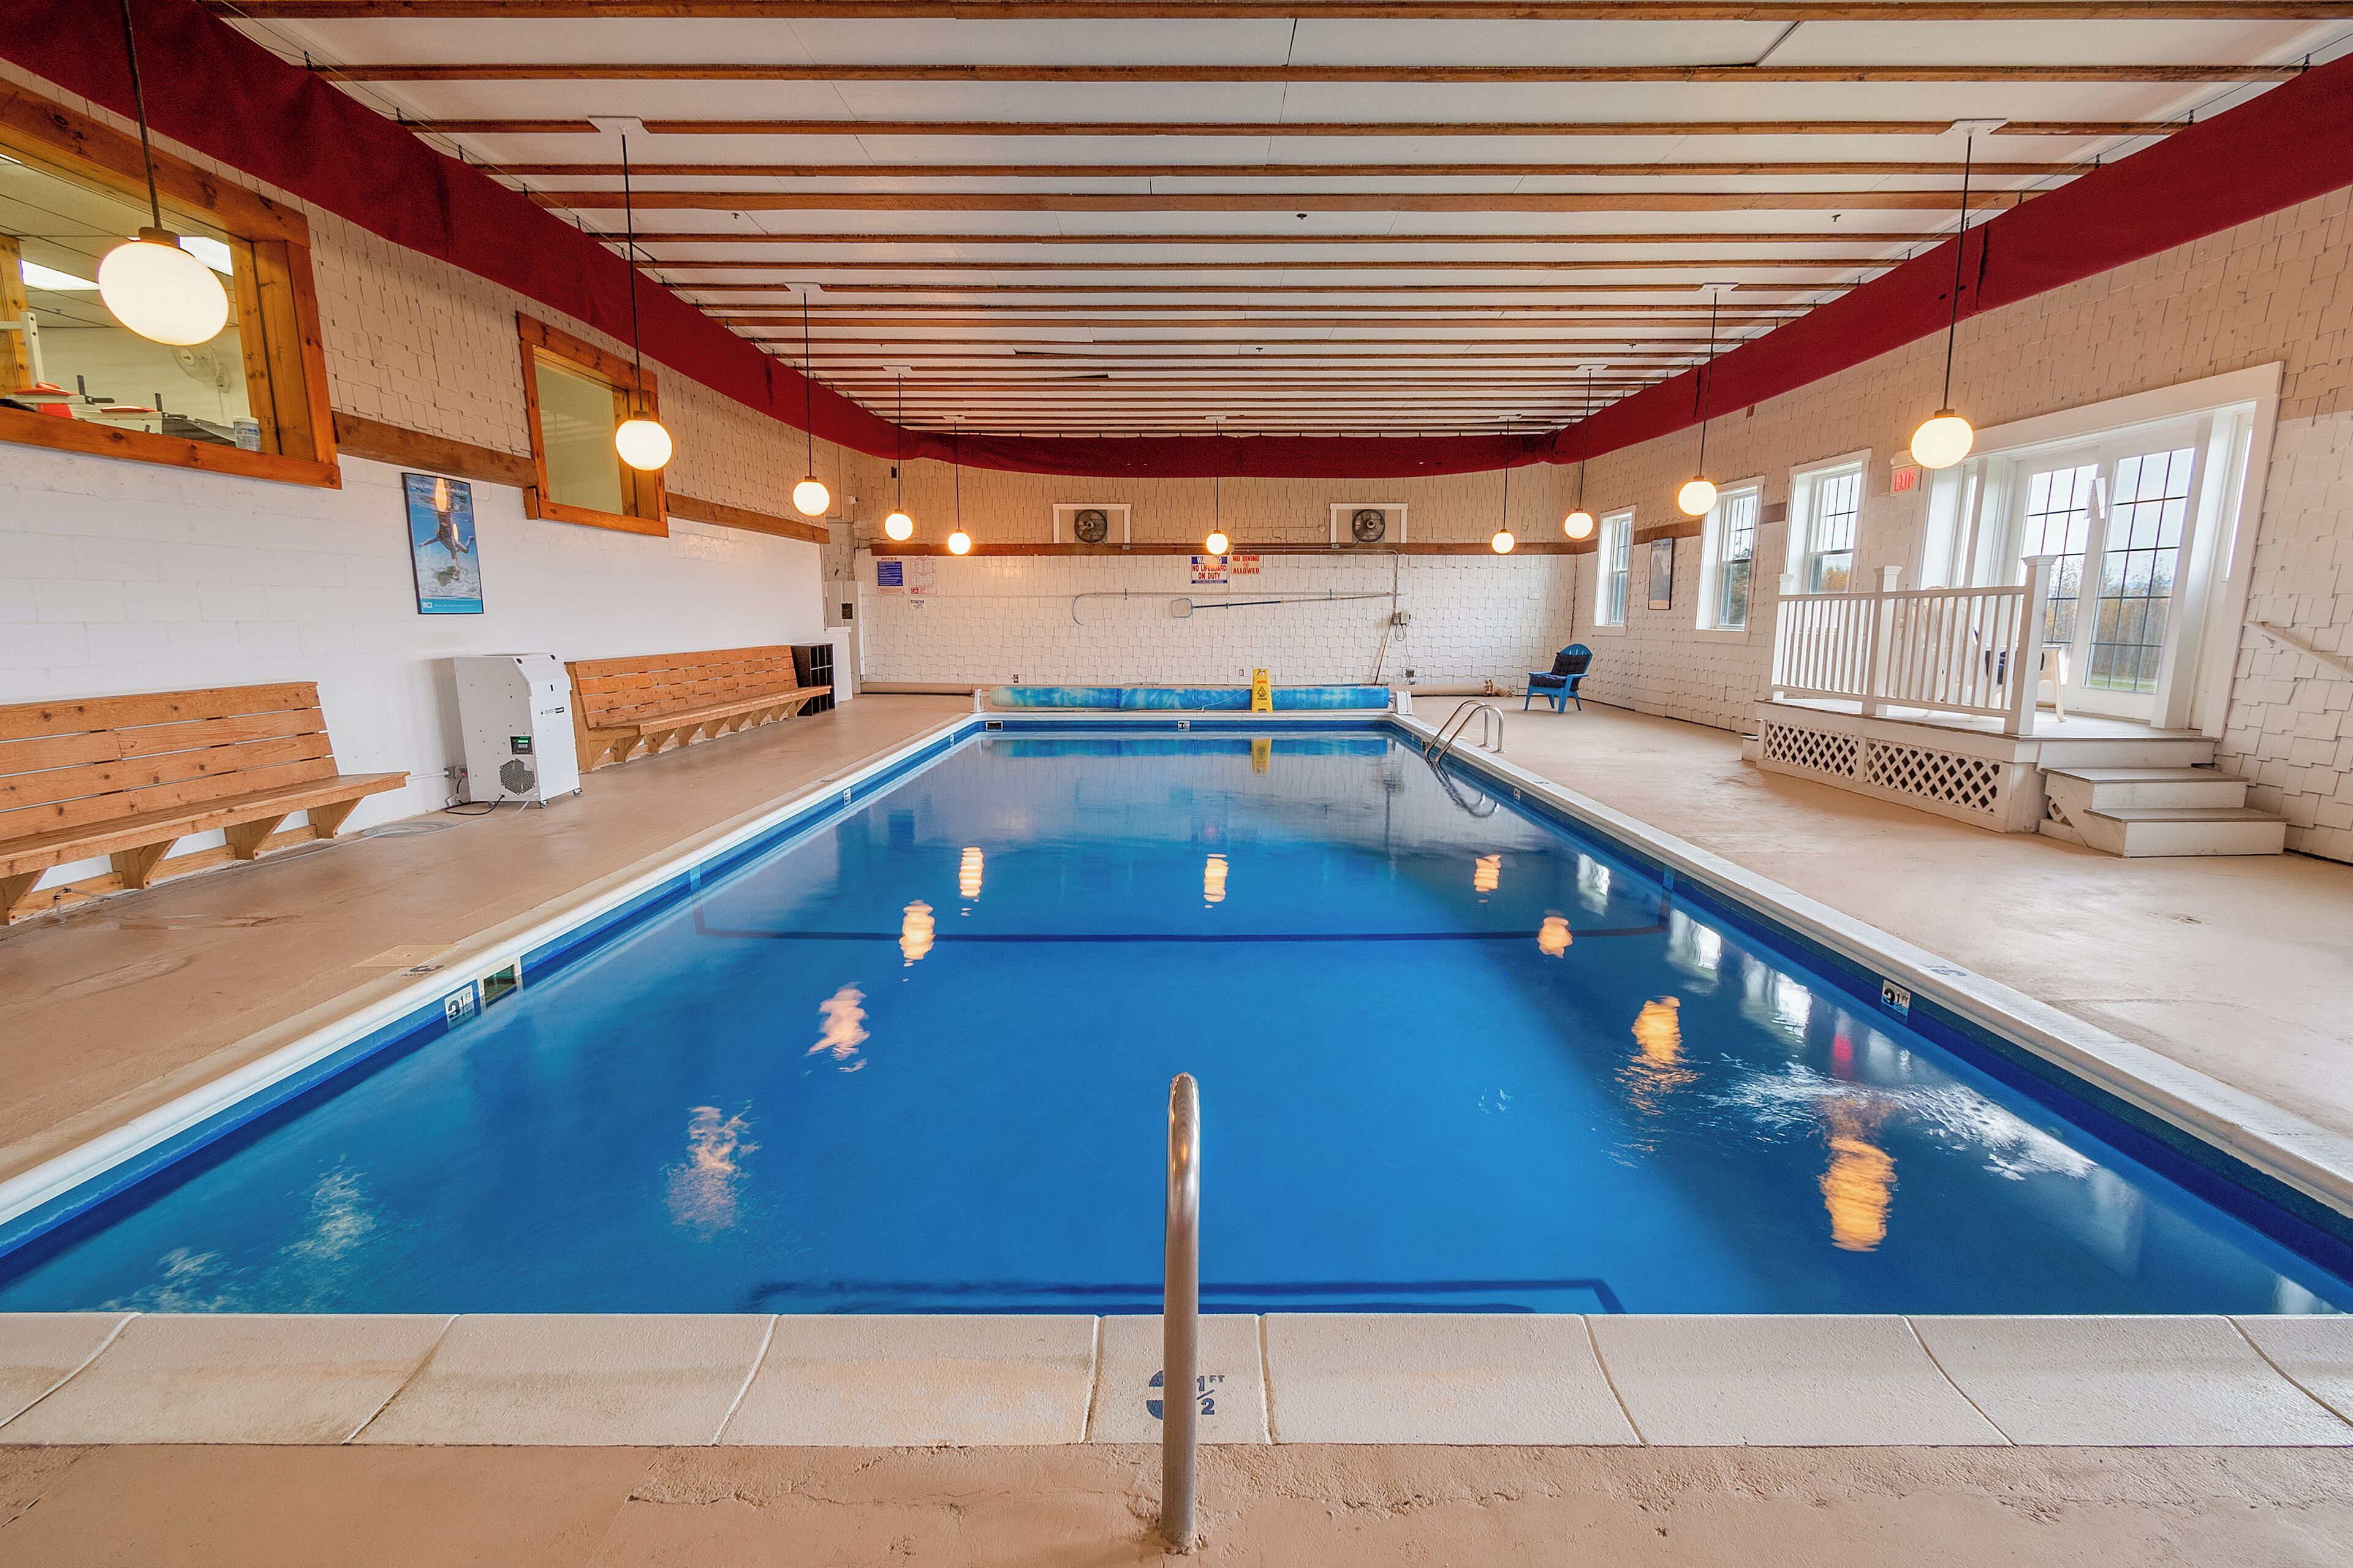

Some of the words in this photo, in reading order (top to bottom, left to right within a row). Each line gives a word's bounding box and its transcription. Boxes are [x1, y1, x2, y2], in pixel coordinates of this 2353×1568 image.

[1894, 469, 1914, 492] EXIT
[1883, 988, 1895, 1006] 3
[448, 1000, 461, 1018] 3
